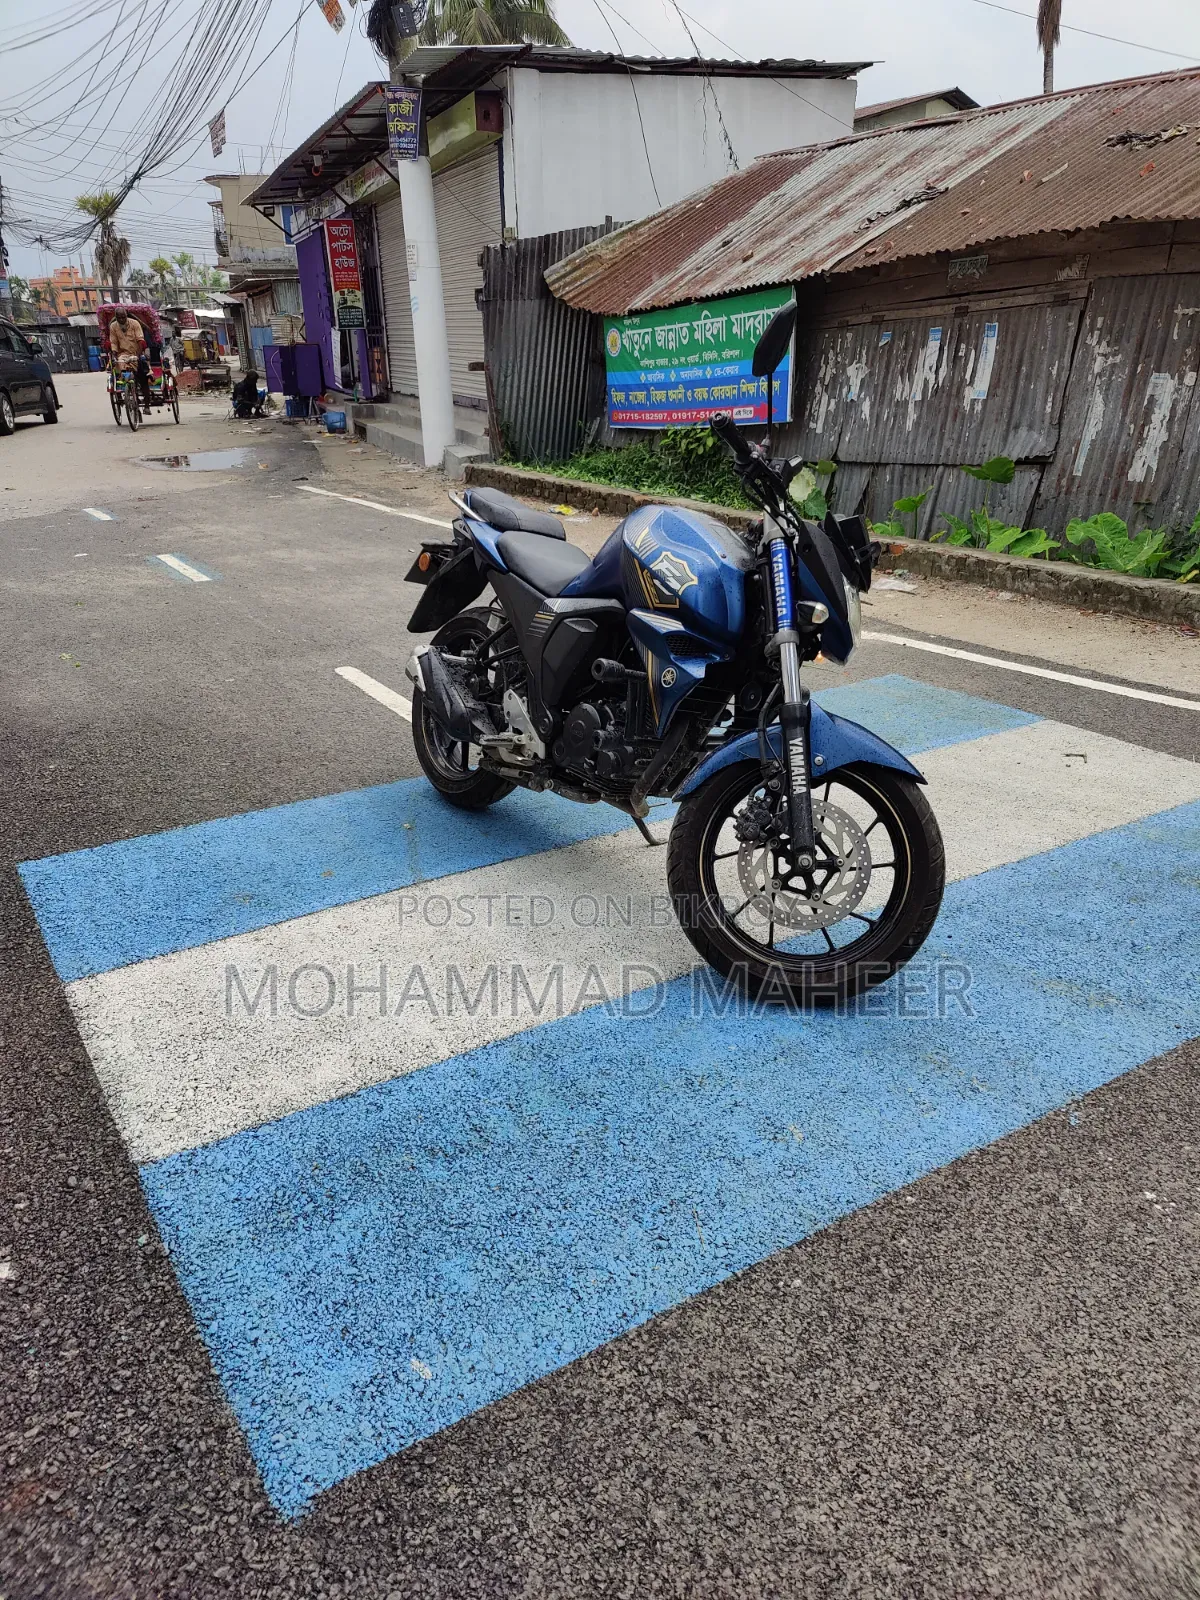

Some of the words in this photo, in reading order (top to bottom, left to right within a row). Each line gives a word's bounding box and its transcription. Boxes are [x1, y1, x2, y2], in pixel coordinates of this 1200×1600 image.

[388, 99, 414, 117] কাজী
[388, 117, 417, 135] অফিস
[329, 223, 352, 237] অটো
[331, 239, 354, 253] পার্টস
[334, 256, 356, 270] হাউজ
[622, 328, 653, 360] খাতুনে
[654, 322, 690, 353] জান্নাত
[692, 310, 727, 345] মহিলা
[709, 384, 738, 401] কোরআন
[739, 378, 758, 399] শিক্ষা
[759, 376, 781, 398] বিাগ
[618, 412, 670, 421] 01715-182597,
[671, 409, 732, 420] 01917-5140
[772, 552, 787, 617] YAMAHA
[788, 737, 807, 795] YAMAHA
